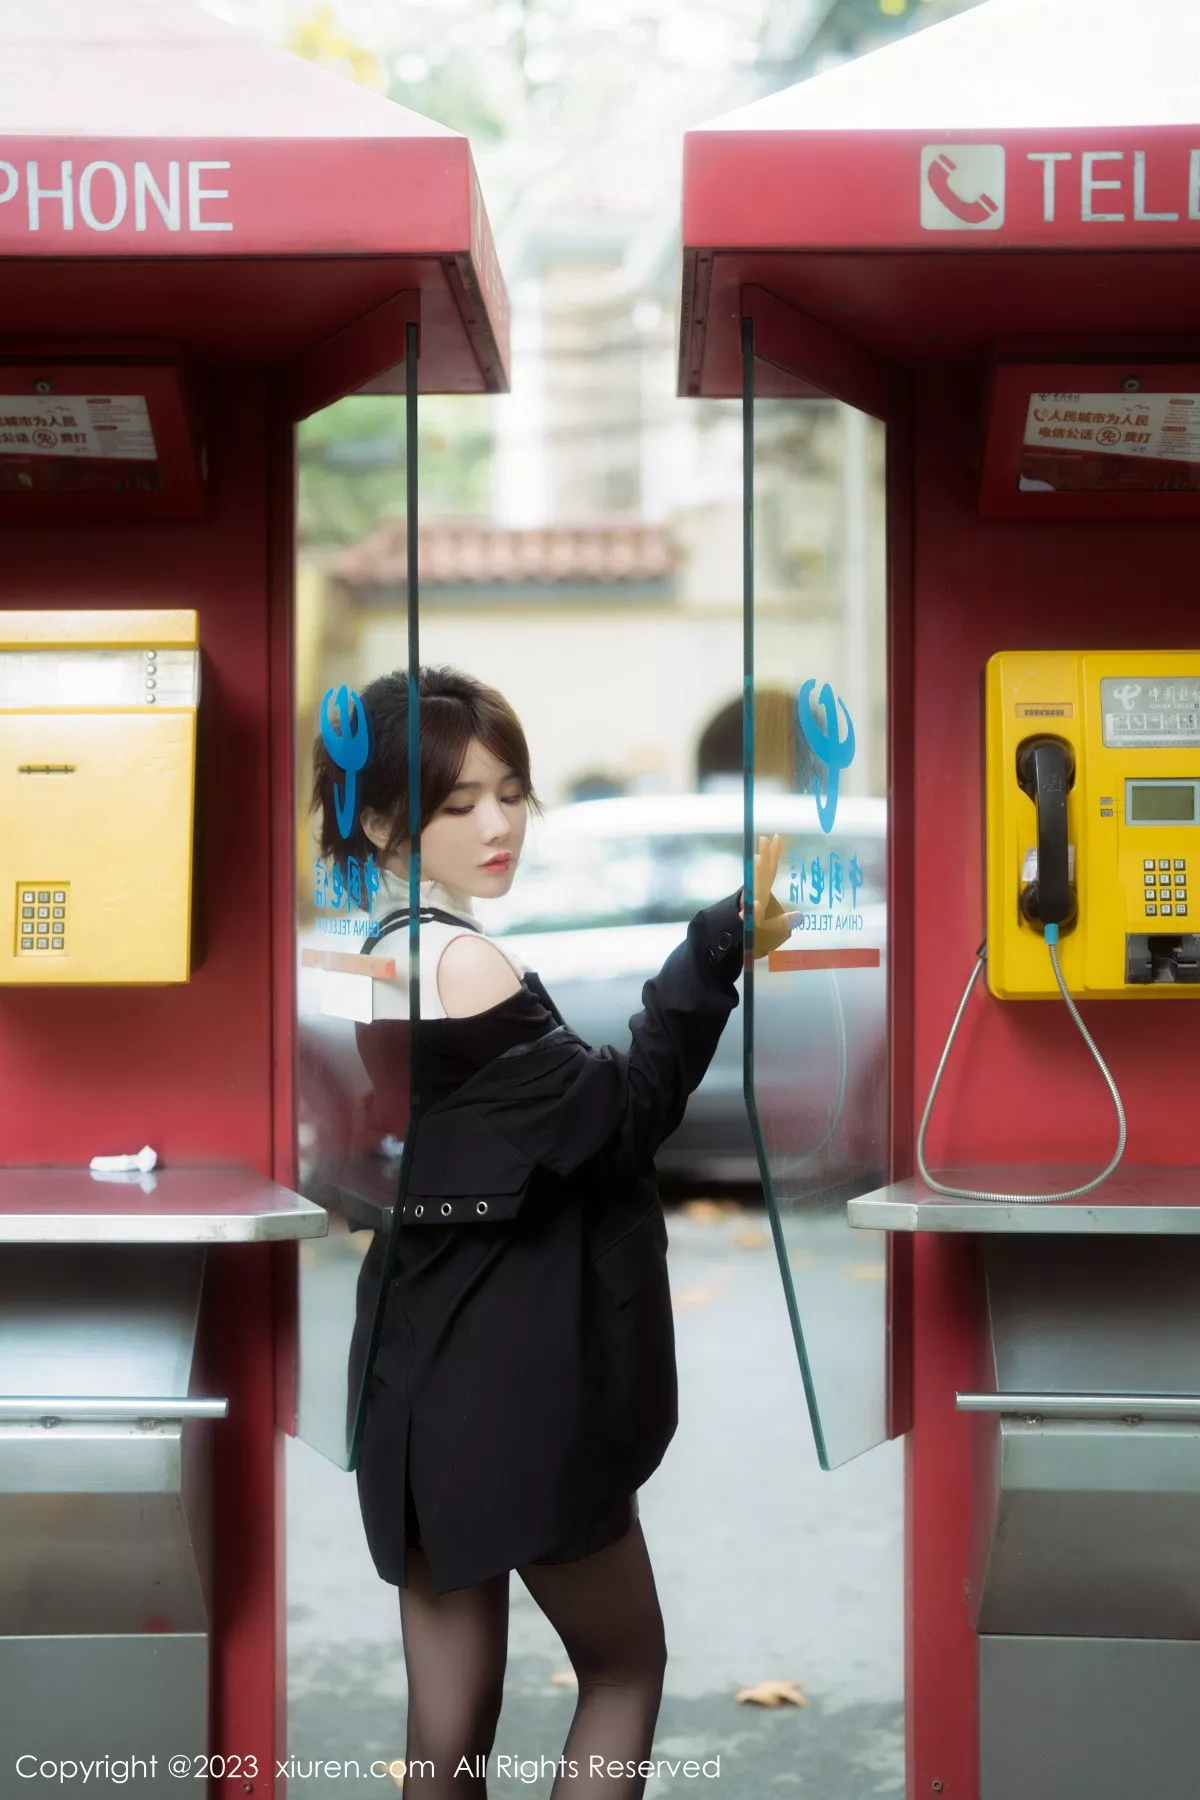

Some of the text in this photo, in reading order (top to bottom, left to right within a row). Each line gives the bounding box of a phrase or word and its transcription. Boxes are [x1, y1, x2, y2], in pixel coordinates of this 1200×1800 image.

[1027, 149, 1200, 222] TEL
[0, 414, 78, 427] 城市为人民
[1048, 409, 1150, 427] 人民城市为人民
